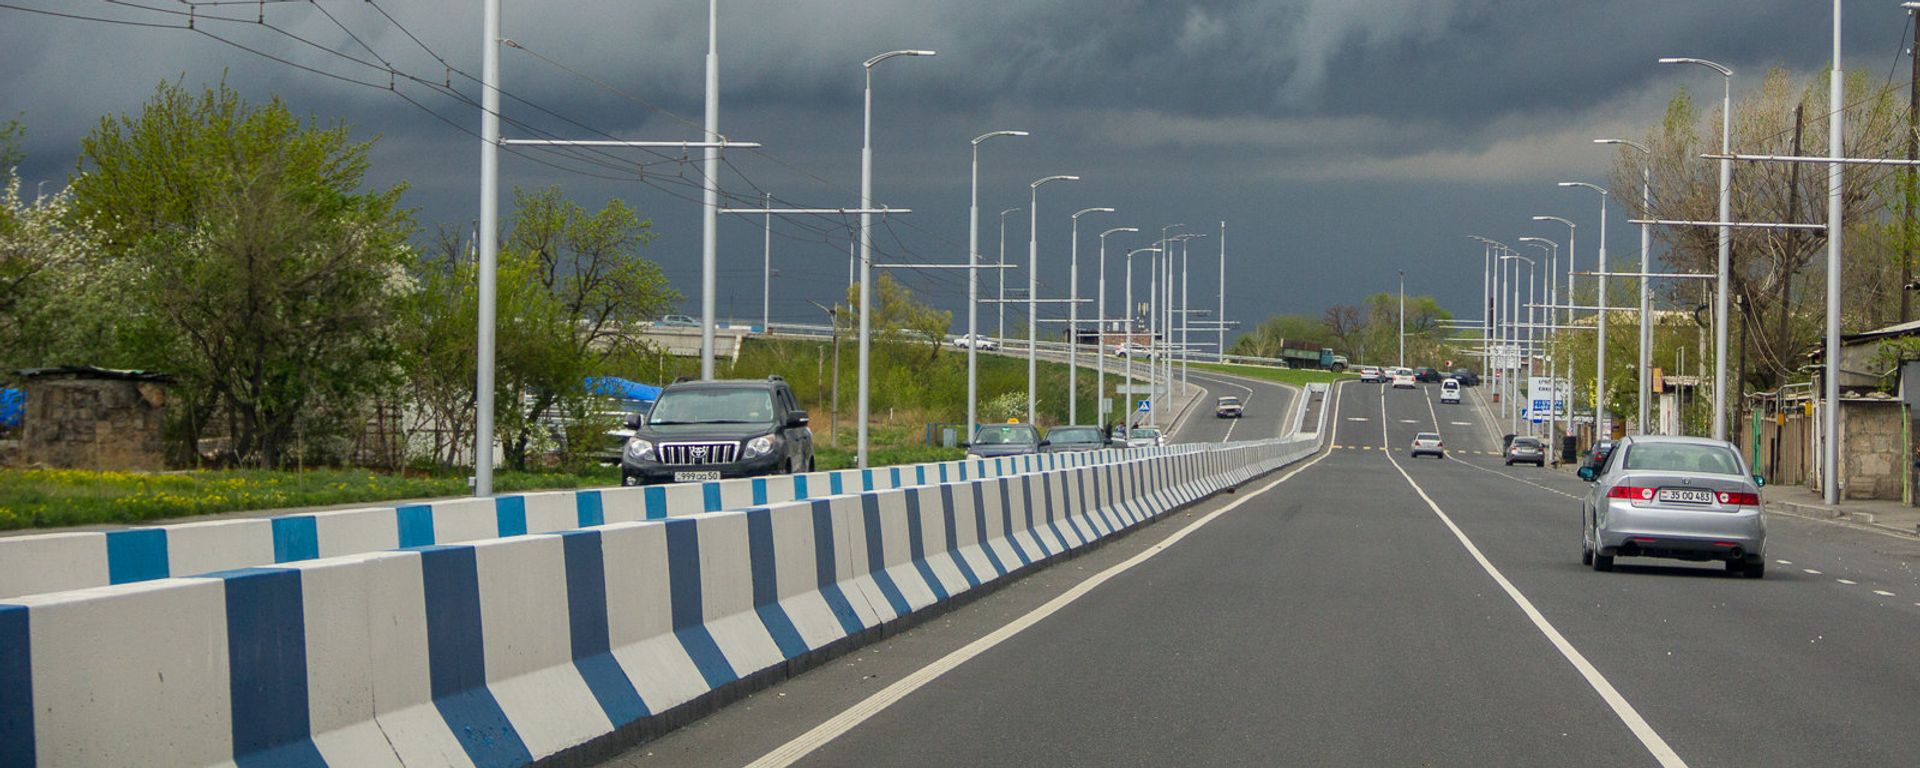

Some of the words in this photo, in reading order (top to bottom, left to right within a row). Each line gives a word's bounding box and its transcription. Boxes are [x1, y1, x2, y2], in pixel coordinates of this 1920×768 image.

[681, 472, 696, 480] 999
[708, 471, 718, 480] 50
[1671, 490, 1680, 499] 35
[1695, 492, 1710, 501] 483
